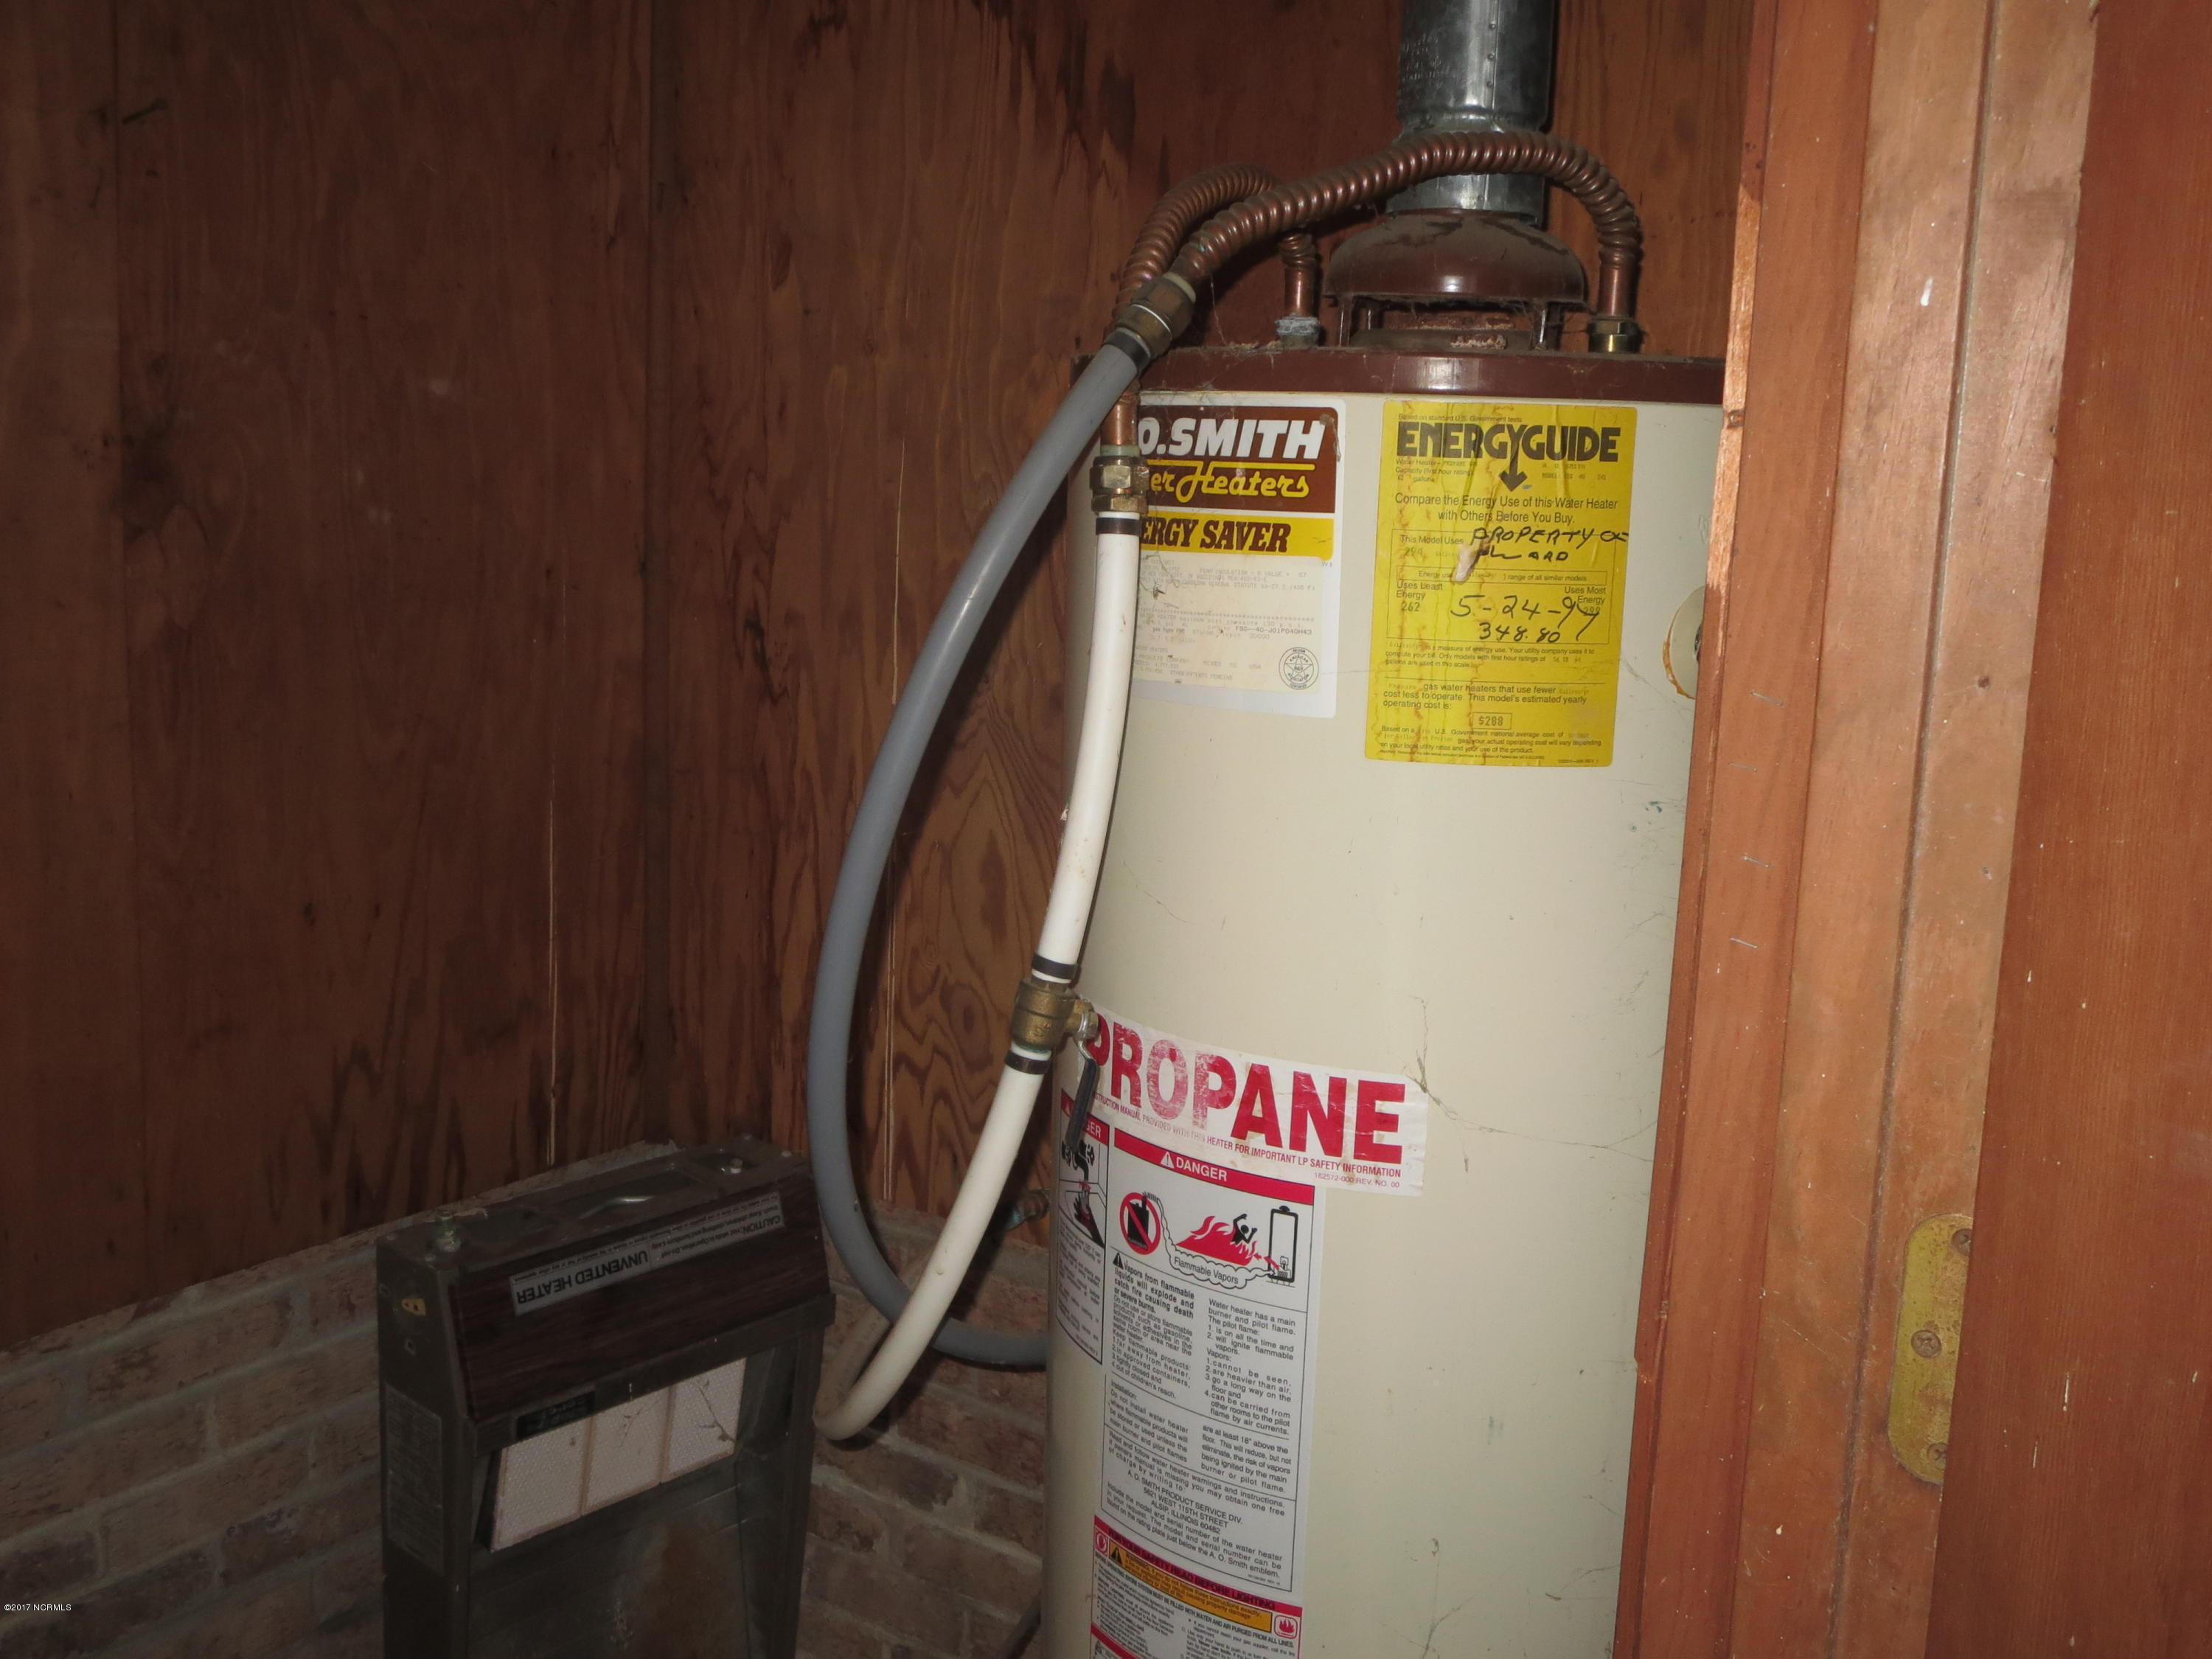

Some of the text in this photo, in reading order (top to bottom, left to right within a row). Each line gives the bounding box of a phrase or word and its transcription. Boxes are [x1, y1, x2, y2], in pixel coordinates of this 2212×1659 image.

[1397, 422, 1621, 462] ENERGYGUIDE
[1175, 460, 1310, 503] Heaters
[1395, 493, 1618, 509] Compare the Energy Use of this Water Heater
[1439, 509, 1575, 524] with Others Before You Buy.
[1140, 516, 1291, 552] ERGY SAVER
[1401, 535, 1464, 545] This Model Uses
[1470, 526, 1594, 549] PROPERTY
[1396, 591, 1425, 600] Energy
[1397, 582, 1442, 591] Uses Least
[1564, 586, 1606, 595] Uses Most
[1401, 601, 1420, 612] 262
[1577, 596, 1604, 605] Energy
[1479, 622, 1560, 643] 348.80
[1467, 685, 1497, 693] heaters
[1498, 685, 1514, 693] that
[1534, 686, 1556, 694] fewer
[1468, 693, 1485, 701] This
[1488, 695, 1519, 703] model's
[1521, 695, 1559, 703] estimated
[1562, 696, 1587, 705] yearly
[1383, 701, 1421, 710] operating
[1478, 716, 1503, 726] $288
[1120, 1104, 1140, 1119] MANUAL
[1207, 1135, 1232, 1150] HEATER
[1234, 1143, 1248, 1154] FOR
[1251, 1147, 1295, 1164] IMPORTANT
[1298, 1156, 1307, 1166] LP
[1310, 1158, 1340, 1170] SAFETY
[1343, 1164, 1400, 1177] INFORMATION
[1176, 1156, 1226, 1181] DANGER
[516, 1250, 648, 1304] UNVENTED HEATER
[1174, 1256, 1238, 1284] Flammable Vapors
[1115, 1267, 1193, 1309] liquids will explode and
[1145, 1273, 1158, 1284] from
[1161, 1279, 1194, 1299] flammable
[1115, 1278, 1192, 1318] catch fire causing death
[1208, 1307, 1295, 1335] burner and pilot flame.
[1208, 1315, 1220, 1324] The
[1222, 1320, 1236, 1329] pilot
[1209, 1298, 1228, 1310] Water
[1231, 1304, 1252, 1316] heater
[1255, 1310, 1267, 1321] has
[1277, 1317, 1295, 1326] main
[1231, 1338, 1250, 1349] ignite
[1255, 1345, 1293, 1360] flammable
[1246, 1335, 1257, 1343] the
[1261, 1338, 1276, 1348] time
[1213, 1360, 1240, 1373] cannot
[1248, 1369, 1258, 1378] be
[1213, 1368, 1224, 1377] are
[1227, 1372, 1255, 1385] heavier
[1258, 1380, 1275, 1390] than
[1211, 1384, 1225, 1394] floor
[1231, 1381, 1245, 1392] long
[1249, 1387, 1262, 1397] way
[1211, 1393, 1224, 1402] can
[1239, 1401, 1267, 1413] carried
[1271, 1408, 1290, 1418] from
[1211, 1400, 1227, 1410] other
[1229, 1406, 1251, 1416] rooms
[1262, 1414, 1272, 1422] the
[1274, 1418, 1290, 1427] pilot
[1211, 1408, 1228, 1419] flame
[1232, 1415, 1240, 1423] by
[1141, 1477, 1160, 1492] SMITH
[1161, 1487, 1192, 1506] PRODUCT
[1195, 1502, 1225, 1520] SERVICE
[1158, 1494, 1175, 1507] WEST
[1199, 1512, 1227, 1528] STREET
[1171, 1509, 1197, 1526] ILLINOIS
